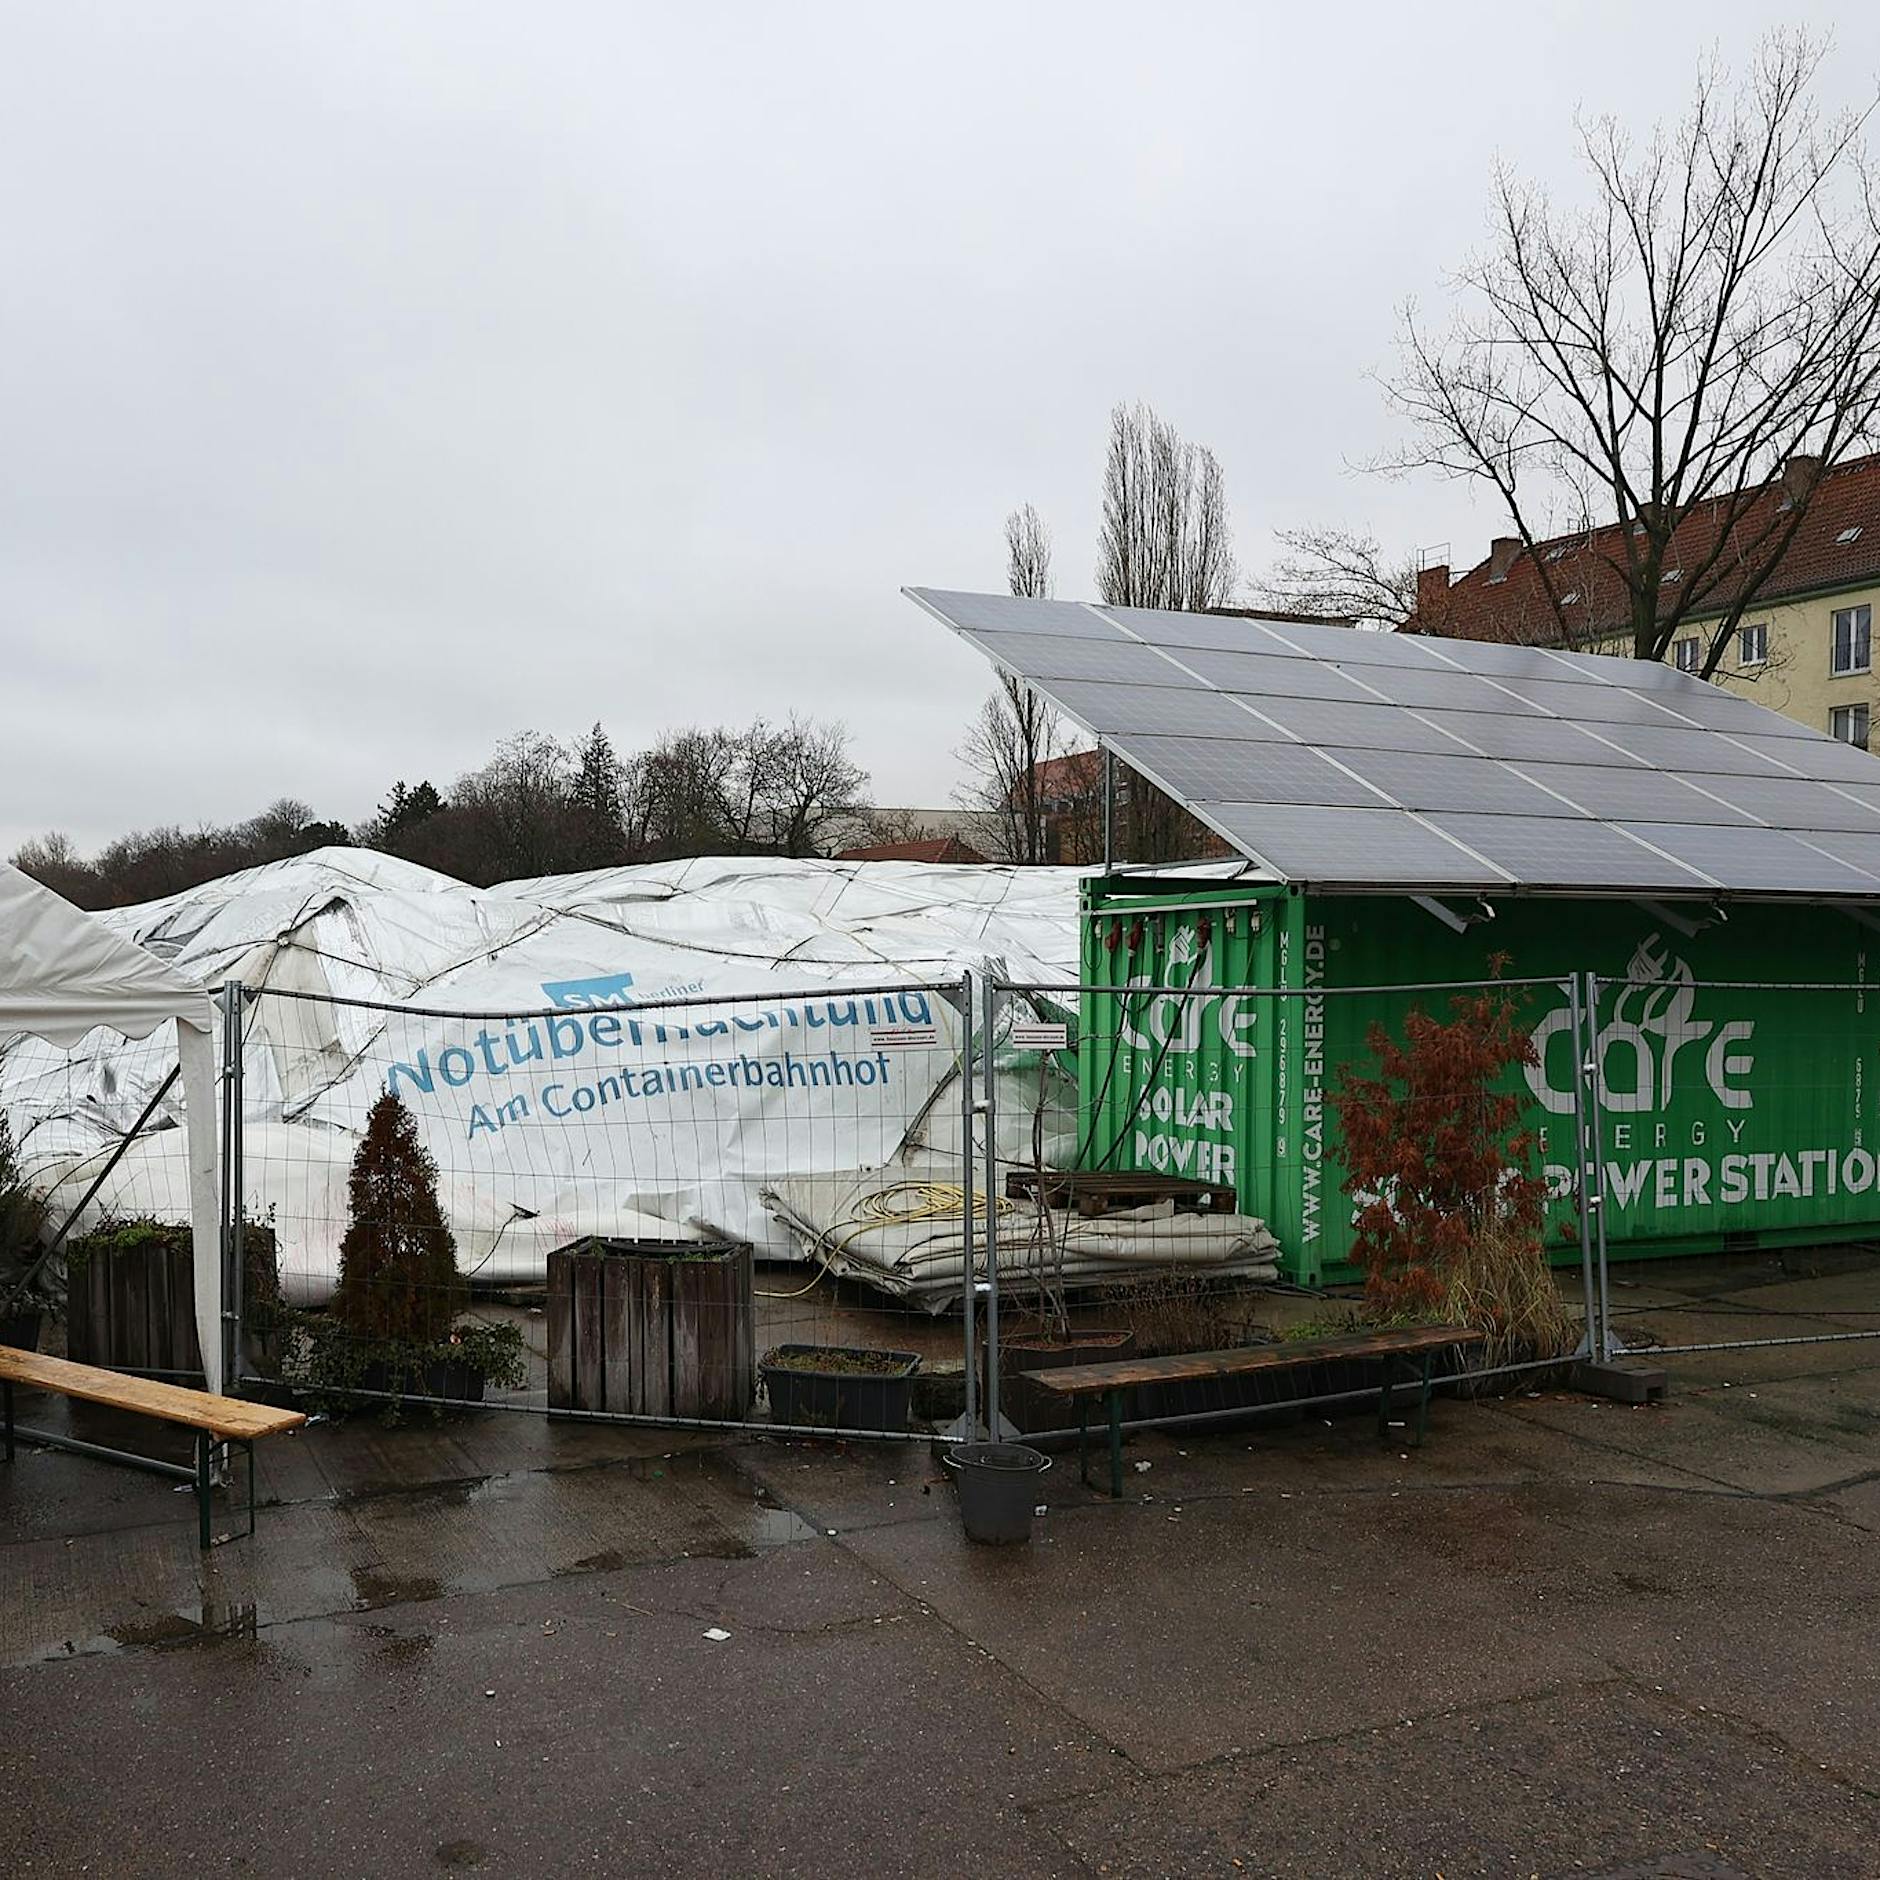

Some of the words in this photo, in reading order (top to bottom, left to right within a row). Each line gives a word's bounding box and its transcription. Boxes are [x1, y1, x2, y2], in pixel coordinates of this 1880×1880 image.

[468, 1093, 530, 1139] Am
[541, 1050, 890, 1118] Containerbahnhof
[1123, 1056, 1243, 1082] ENERGY
[1302, 925, 1326, 1245] WWW.CARE-ENERGY.DE
[1139, 1085, 1234, 1132] SOLAR
[1135, 1130, 1236, 1186] POWER
[1720, 1149, 1880, 1204] STATIO
